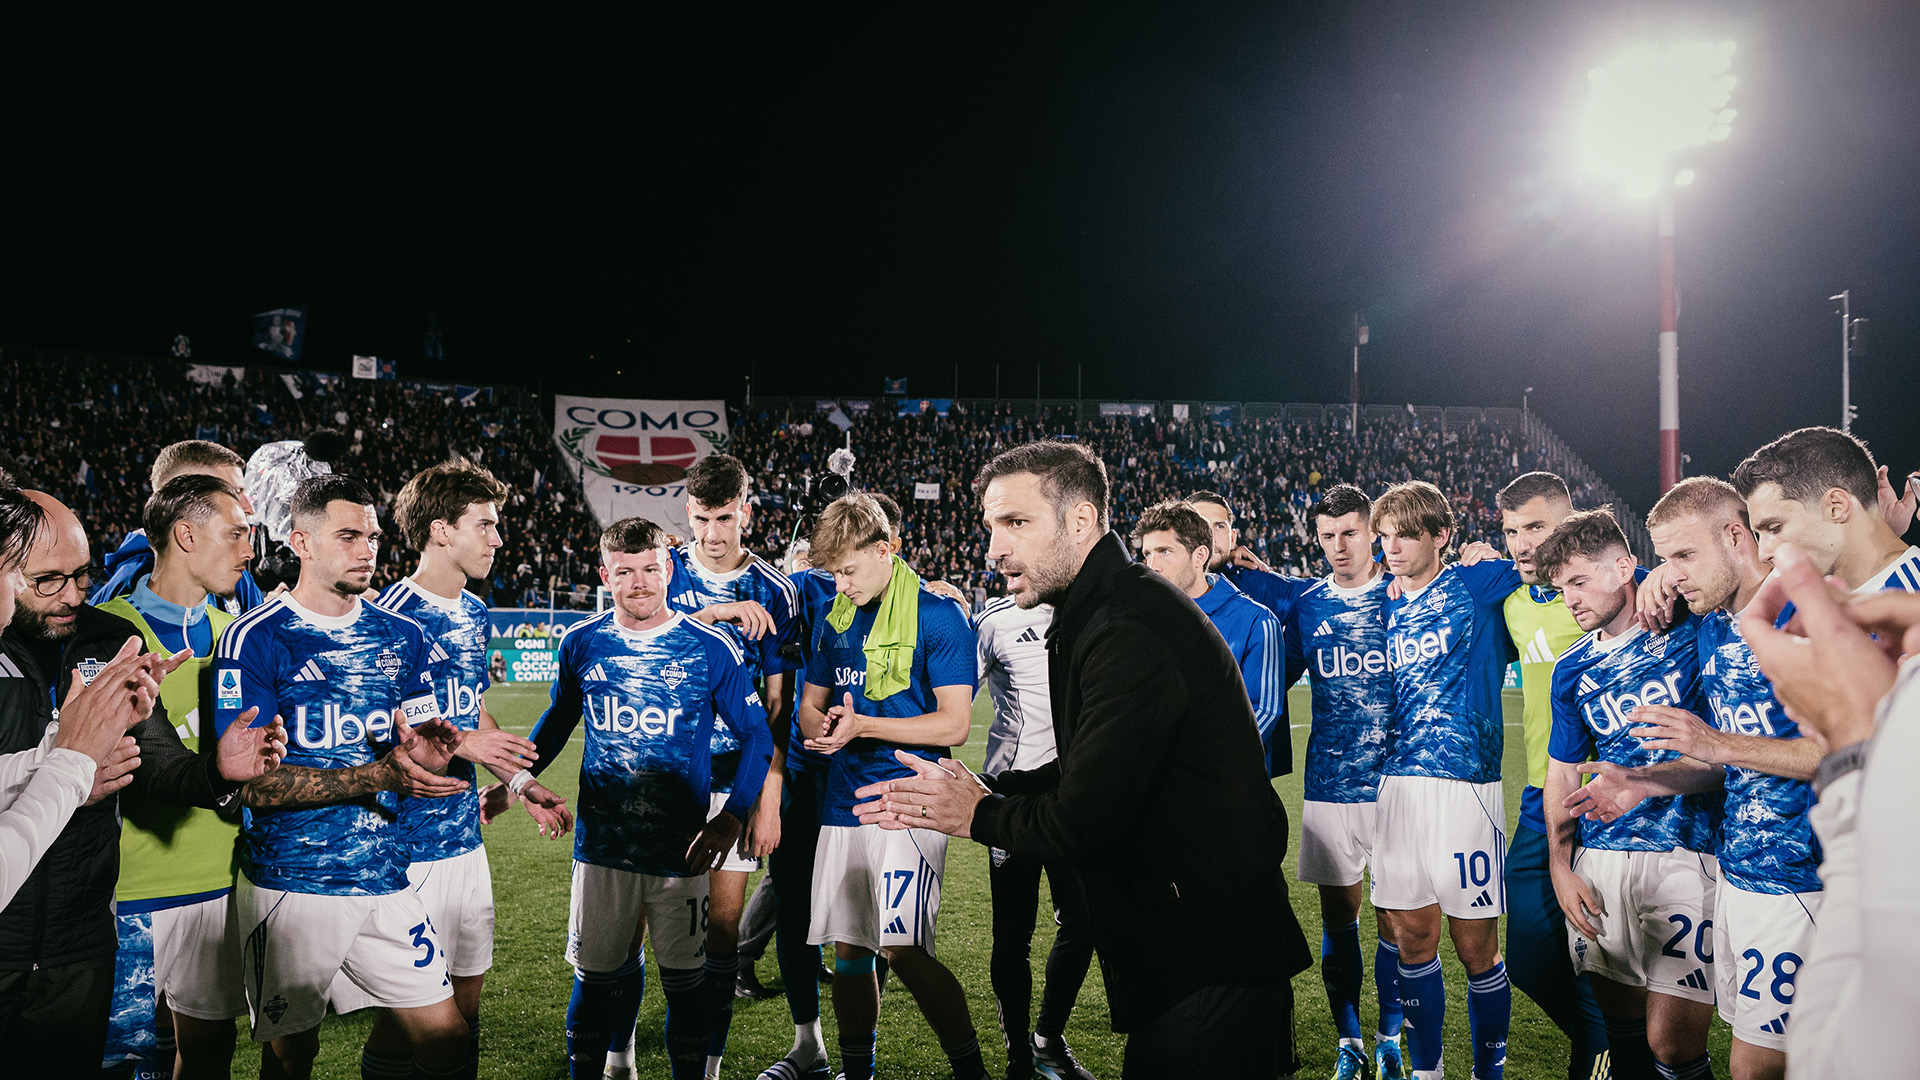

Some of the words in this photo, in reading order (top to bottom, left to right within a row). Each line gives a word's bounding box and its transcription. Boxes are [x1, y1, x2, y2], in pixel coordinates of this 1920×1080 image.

[566, 406, 720, 431] COMO
[612, 484, 686, 498] 1907
[514, 638, 546, 649] OGNI
[521, 651, 553, 661] OGNI
[512, 661, 559, 671] GOCCIA
[514, 671, 559, 681] CONTA
[404, 702, 435, 718] EACE
[587, 694, 683, 736] Uber
[1585, 670, 1683, 736] Uber
[1454, 850, 1490, 889] 10
[884, 870, 914, 910] 17
[686, 895, 709, 937] 18
[1662, 914, 1714, 964] 20
[1739, 948, 1803, 1004] 28
